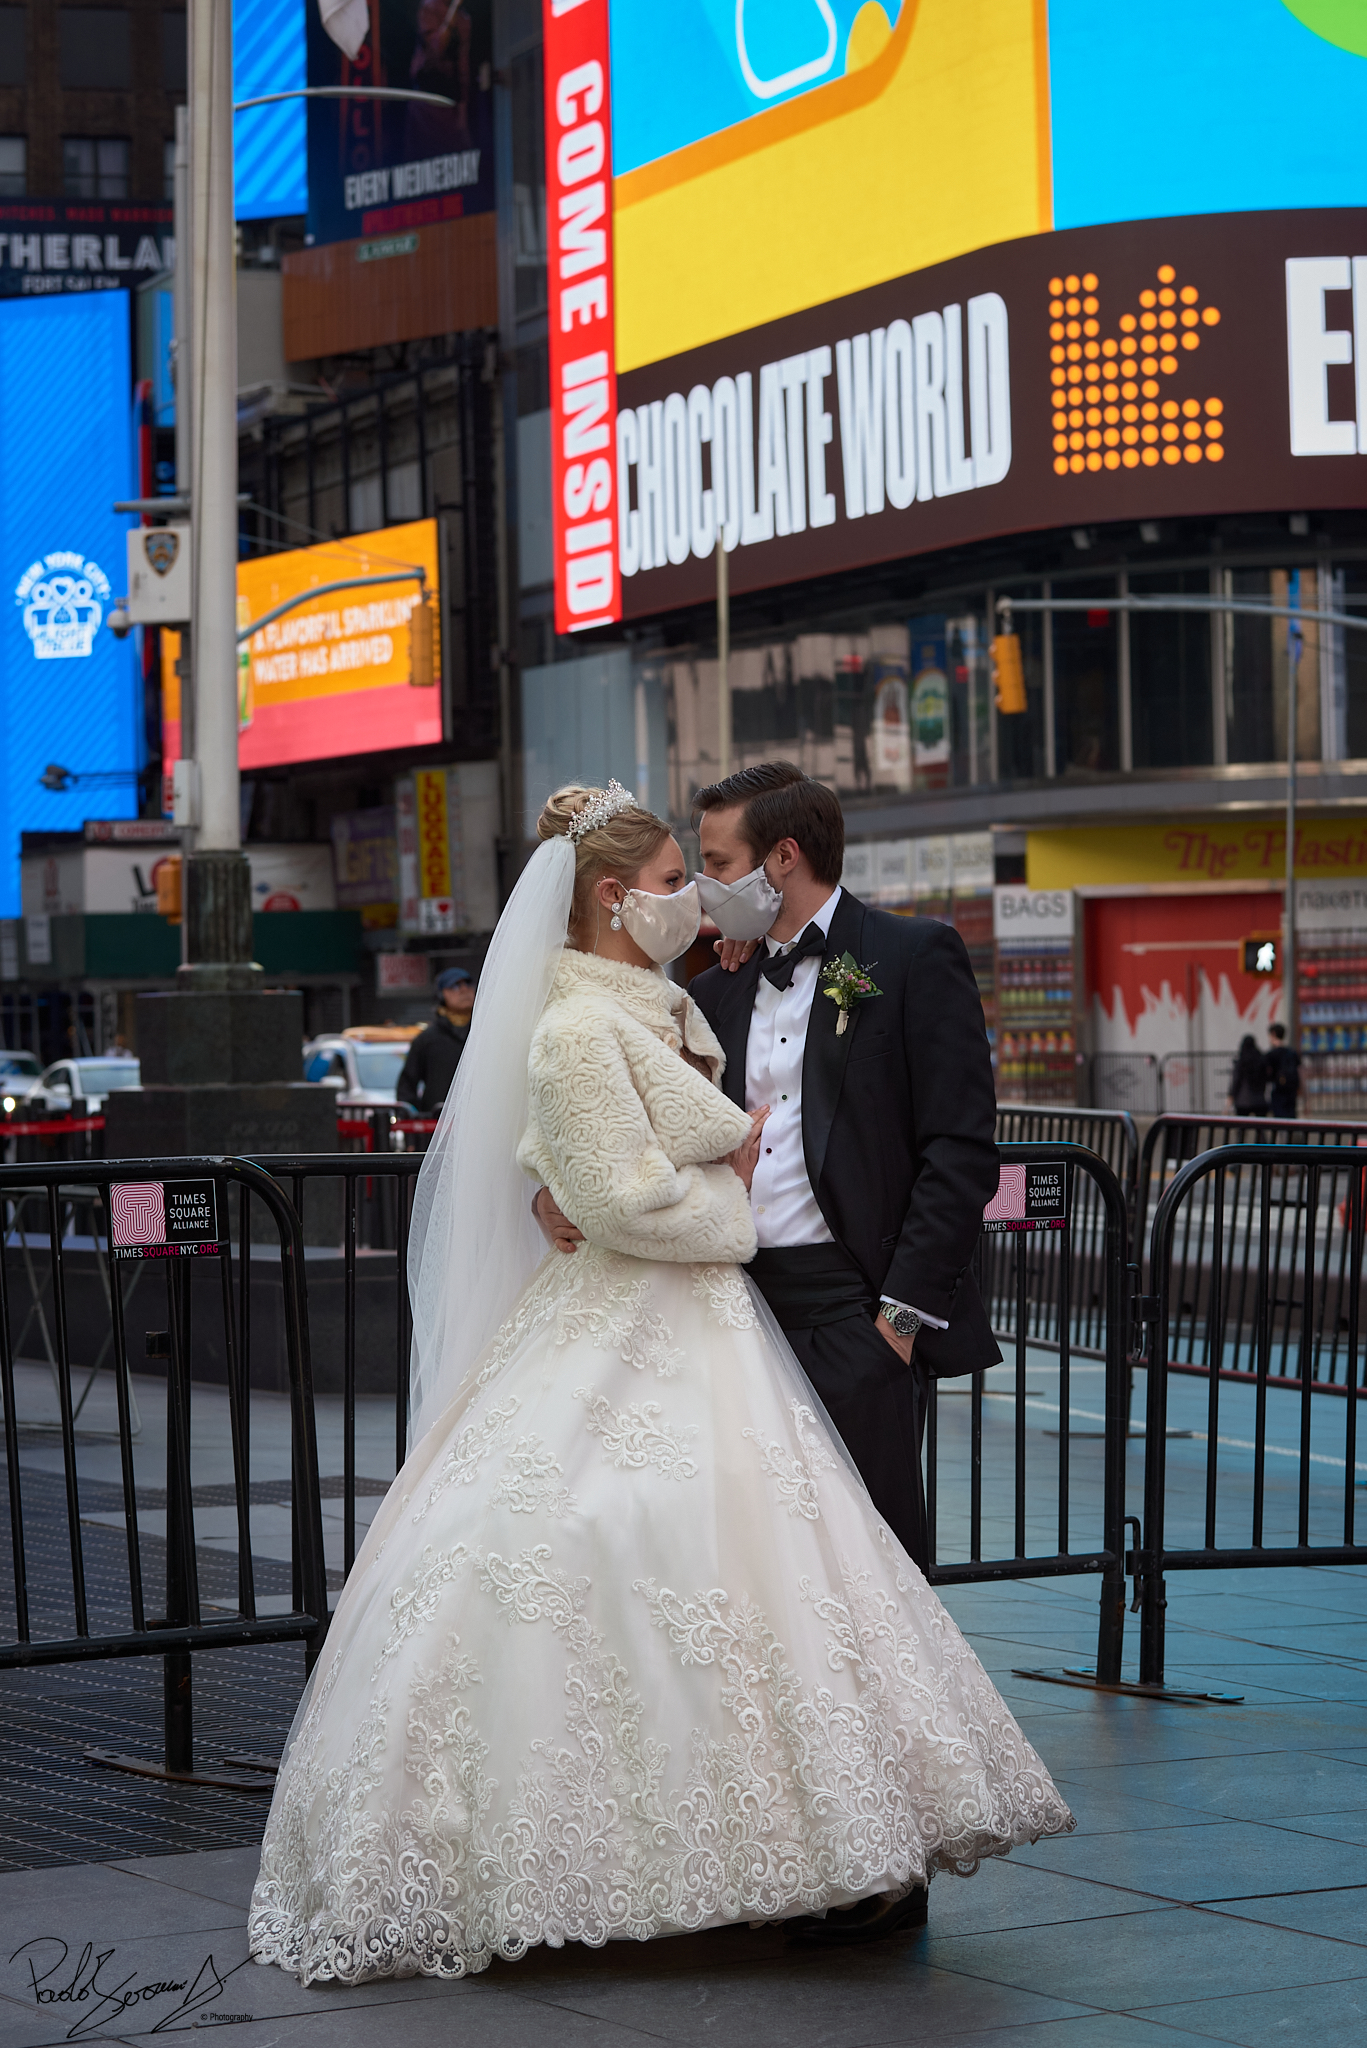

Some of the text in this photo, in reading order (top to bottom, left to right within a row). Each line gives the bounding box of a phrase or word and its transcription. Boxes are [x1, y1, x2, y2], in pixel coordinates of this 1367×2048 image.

[344, 149, 481, 210] EVERY WEDNESDAY
[556, 60, 608, 333] COME
[22, 274, 63, 294] FORT
[1285, 256, 1367, 457] E
[616, 292, 1012, 578] CHOCOLATE WORLD
[561, 351, 615, 633] INSID
[14, 550, 112, 599] NEW YORK CITY
[254, 633, 394, 686] WATER HAS ARRIVED
[423, 772, 447, 897] LUGGAGE
[1163, 830, 1239, 879] The
[1001, 893, 1064, 919] BAGS
[1028, 1186, 1061, 1198] SQUARE
[1031, 1174, 1059, 1186] TIMES
[172, 1193, 206, 1206] TIMES
[1030, 1198, 1059, 1207] ALLIANCE
[169, 1206, 211, 1220] SQUARE
[172, 1219, 210, 1230] ALLIANCE
[983, 1219, 1066, 1232] TIMESSQUARENYC.ORG
[113, 1243, 219, 1259] TIMESSQUARENYC.ORG
